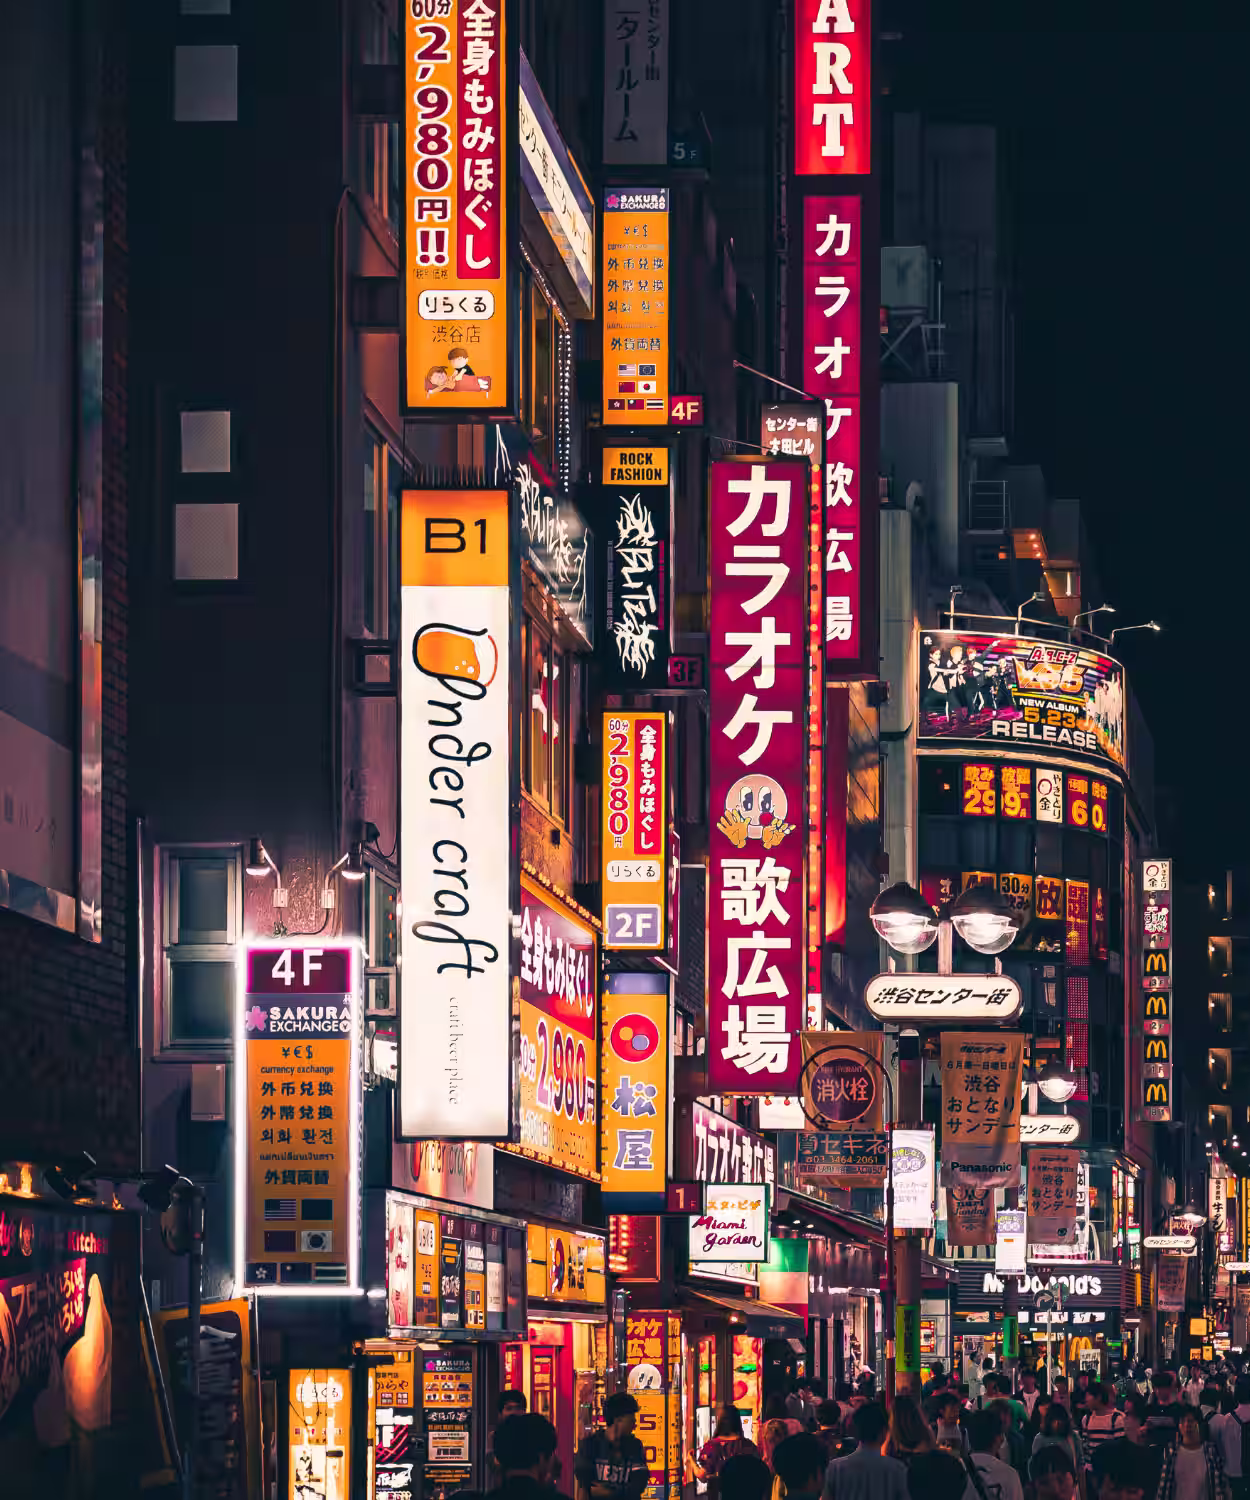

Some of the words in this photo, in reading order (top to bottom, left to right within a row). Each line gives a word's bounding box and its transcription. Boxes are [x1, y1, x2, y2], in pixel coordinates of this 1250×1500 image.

[425, 296, 488, 314] りらくる
[671, 402, 699, 421] 4F
[619, 452, 653, 466] ROCK
[610, 467, 662, 481] FASHION
[424, 517, 488, 554] B1
[673, 661, 697, 682] 3F
[1019, 697, 1045, 710] NEW
[1045, 701, 1080, 714] ALBUM
[1023, 707, 1076, 729] 5.23
[991, 720, 1097, 750] RELEASE
[639, 724, 657, 849] 全身もみほぐし
[611, 864, 657, 879] りらくる
[615, 912, 653, 937] 2F
[271, 949, 324, 987] 4F
[519, 905, 594, 1018] 全身もみほぐし
[873, 987, 1013, 1006] 渋谷センター街
[269, 1006, 352, 1020] SAKURA
[269, 1020, 340, 1033] EXCHANGE
[260, 1065, 295, 1076] currency
[297, 1064, 335, 1076] exchange
[816, 1077, 869, 1102] 消火栓
[963, 1075, 1001, 1092] 渋谷
[946, 1096, 1016, 1114] おとなり
[610, 1076, 658, 1171] 松屋
[946, 1118, 1017, 1136] サンデー
[950, 1161, 1013, 1173] Panasonic
[691, 1215, 748, 1231] Miami
[983, 1272, 1103, 1296] MDonald's
